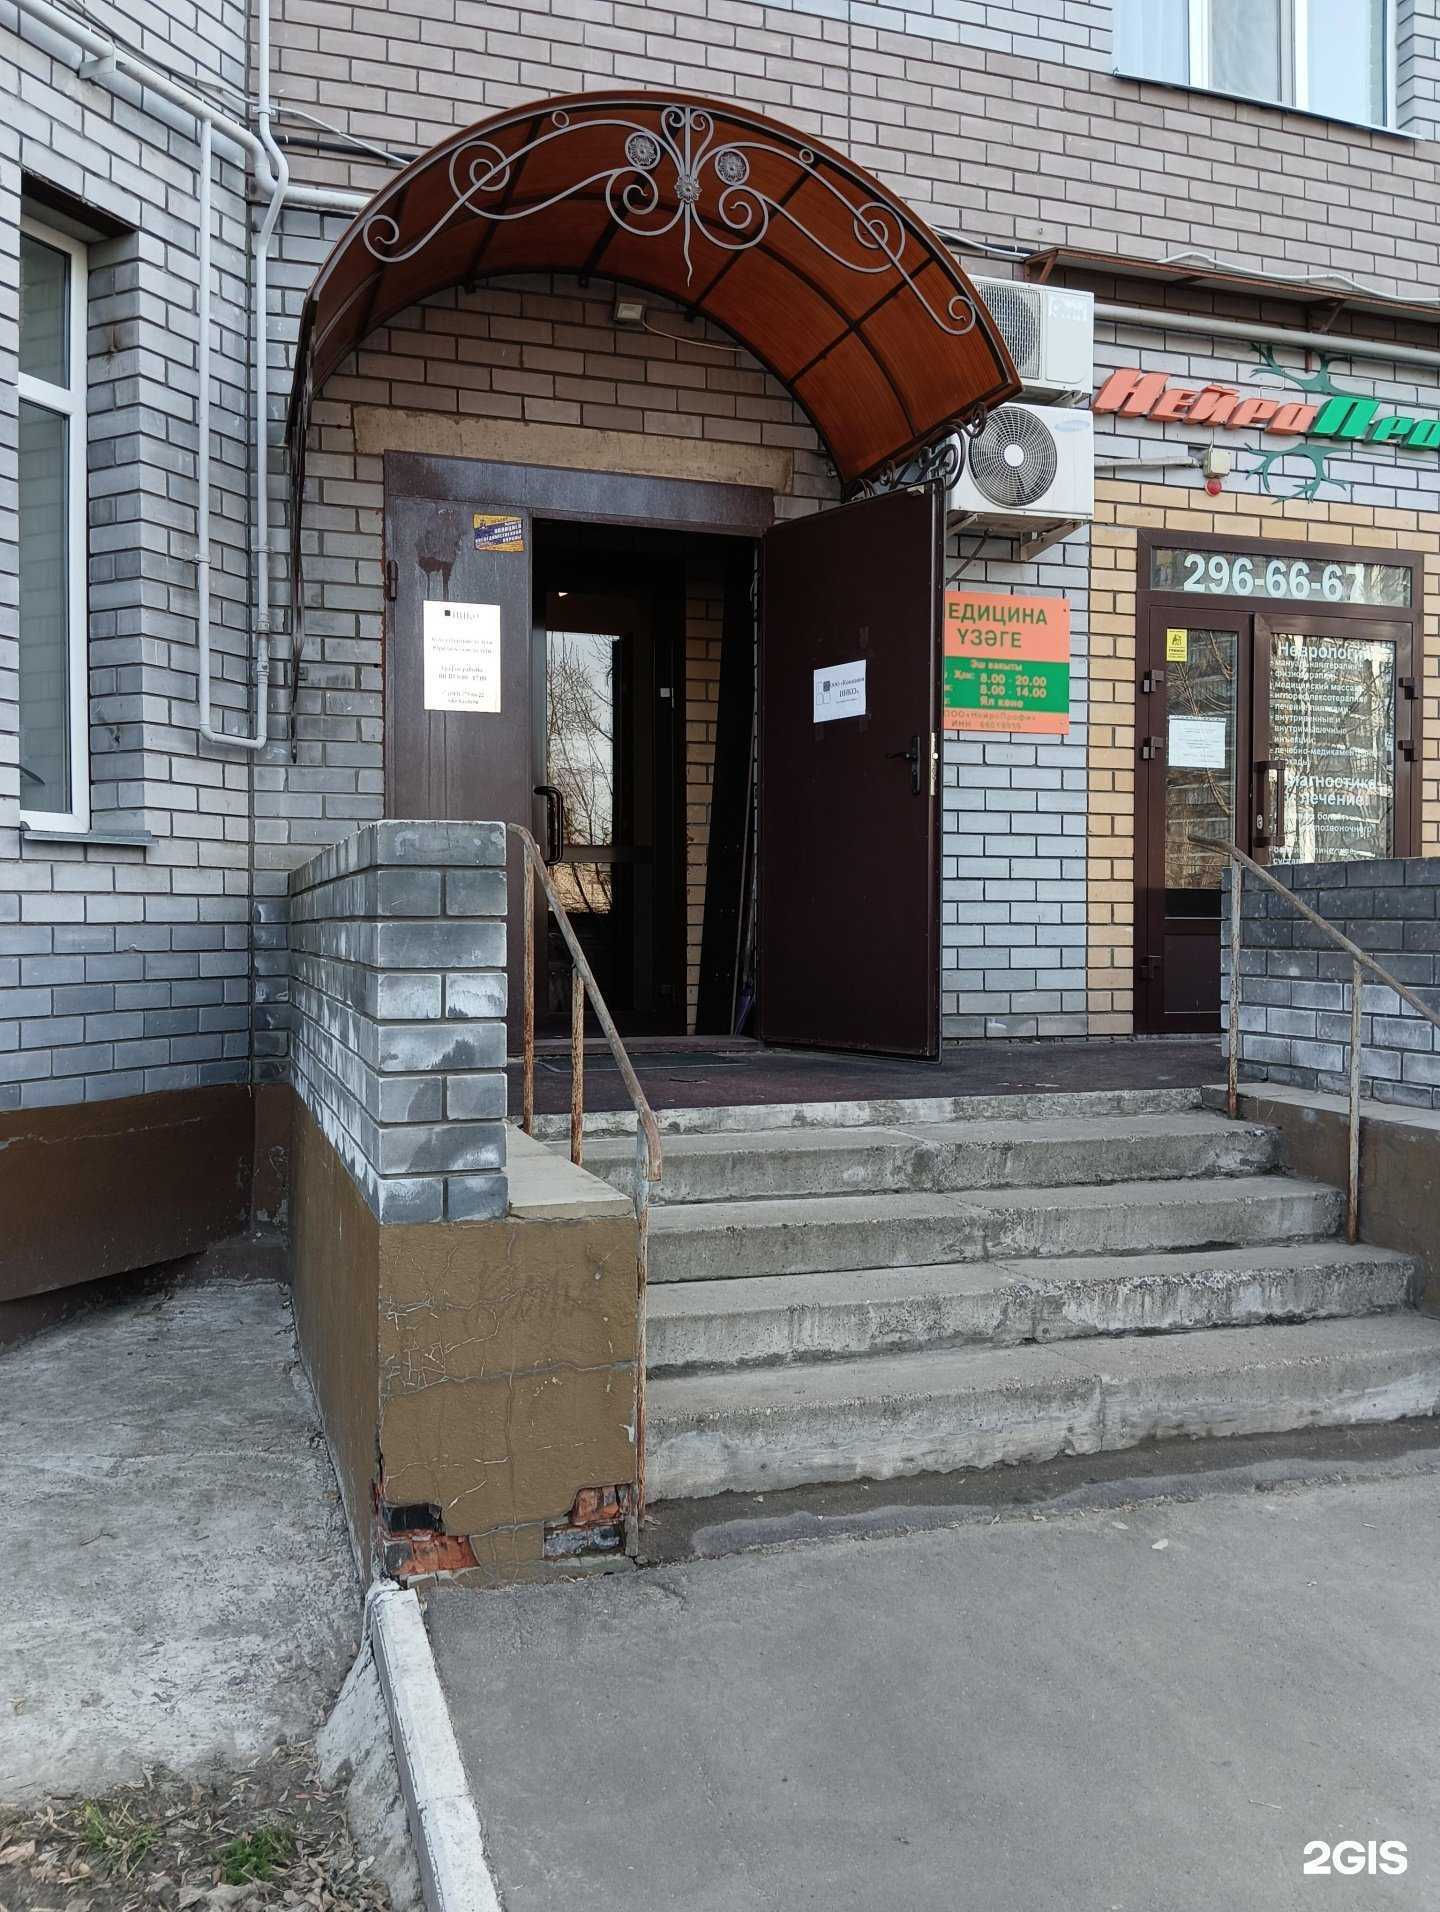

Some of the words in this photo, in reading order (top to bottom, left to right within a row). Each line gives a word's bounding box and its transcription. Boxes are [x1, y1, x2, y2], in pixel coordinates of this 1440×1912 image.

[1184, 554, 1365, 602] 296-66-67
[948, 602, 1048, 626] ЕДИЦИНА
[1280, 641, 1373, 661] Неврологи
[980, 673, 1006, 684] 8.00
[1015, 674, 1047, 687] 20.00
[980, 685, 1006, 696] 8.00
[1016, 686, 1047, 698] 14.00
